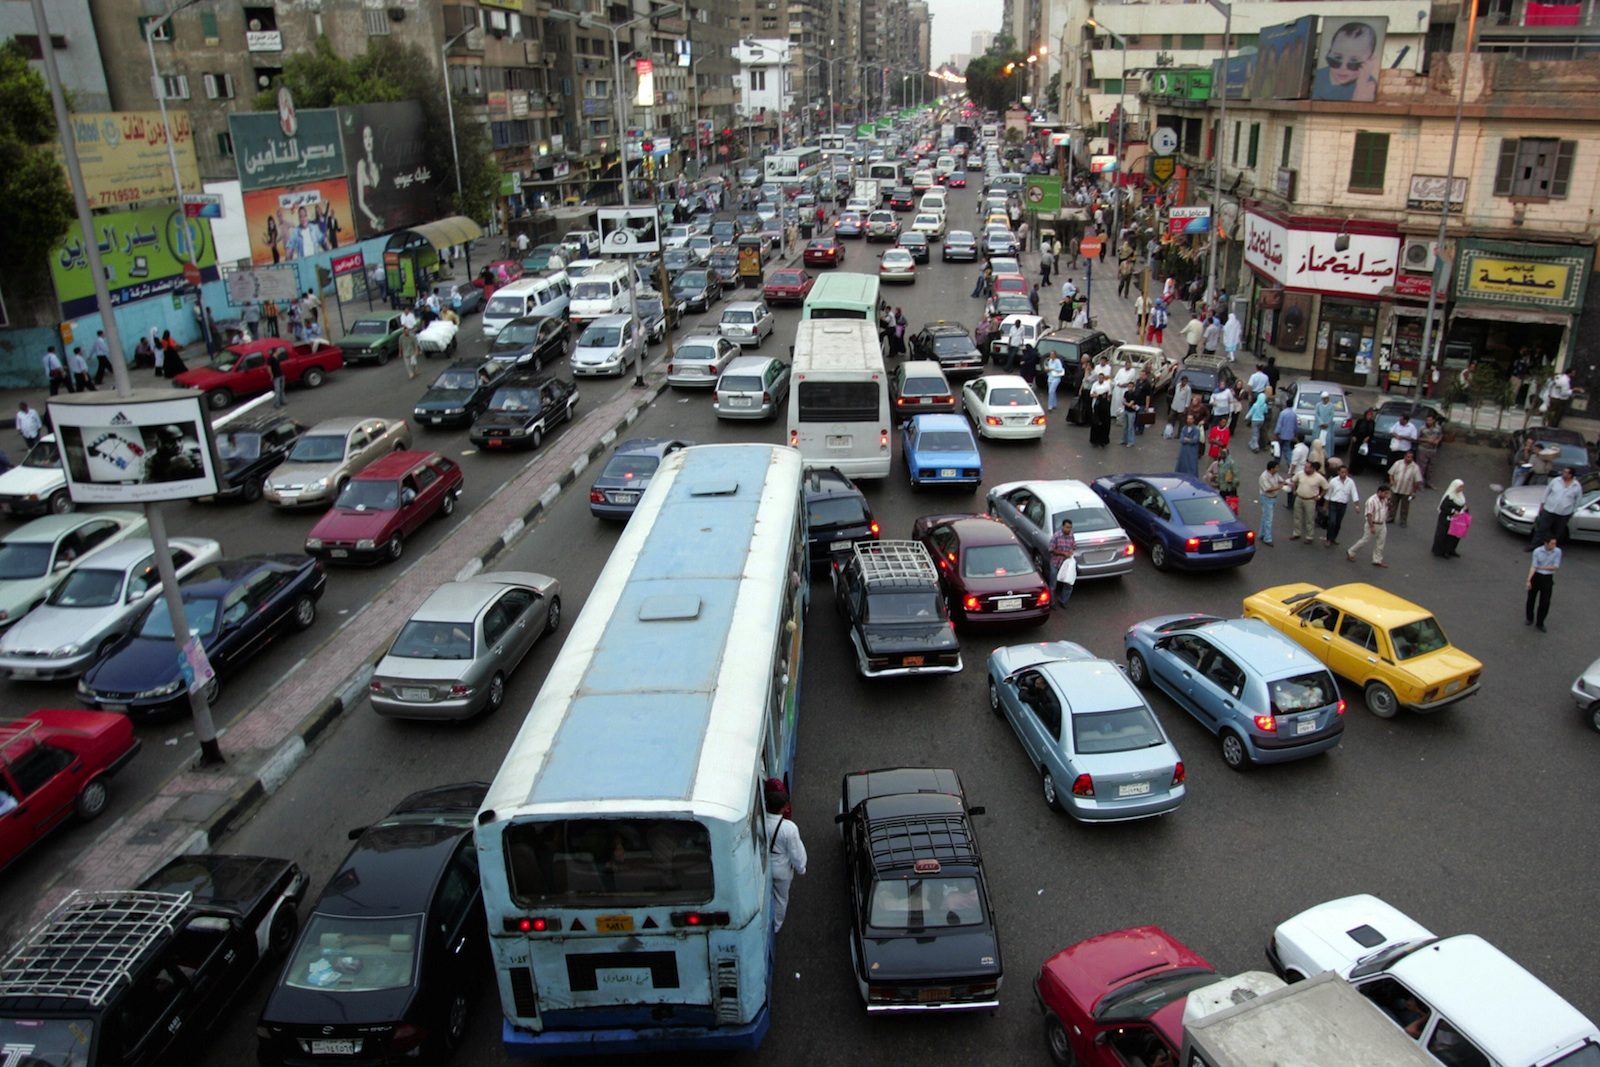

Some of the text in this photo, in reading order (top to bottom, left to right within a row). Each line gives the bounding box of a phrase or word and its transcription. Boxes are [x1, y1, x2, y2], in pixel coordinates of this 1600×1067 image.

[244, 138, 336, 174] مصر للتأمين
[61, 227, 119, 270] الين
[1296, 245, 1393, 282] صيدلية ممتاز
[1480, 269, 1556, 289] عظمة
